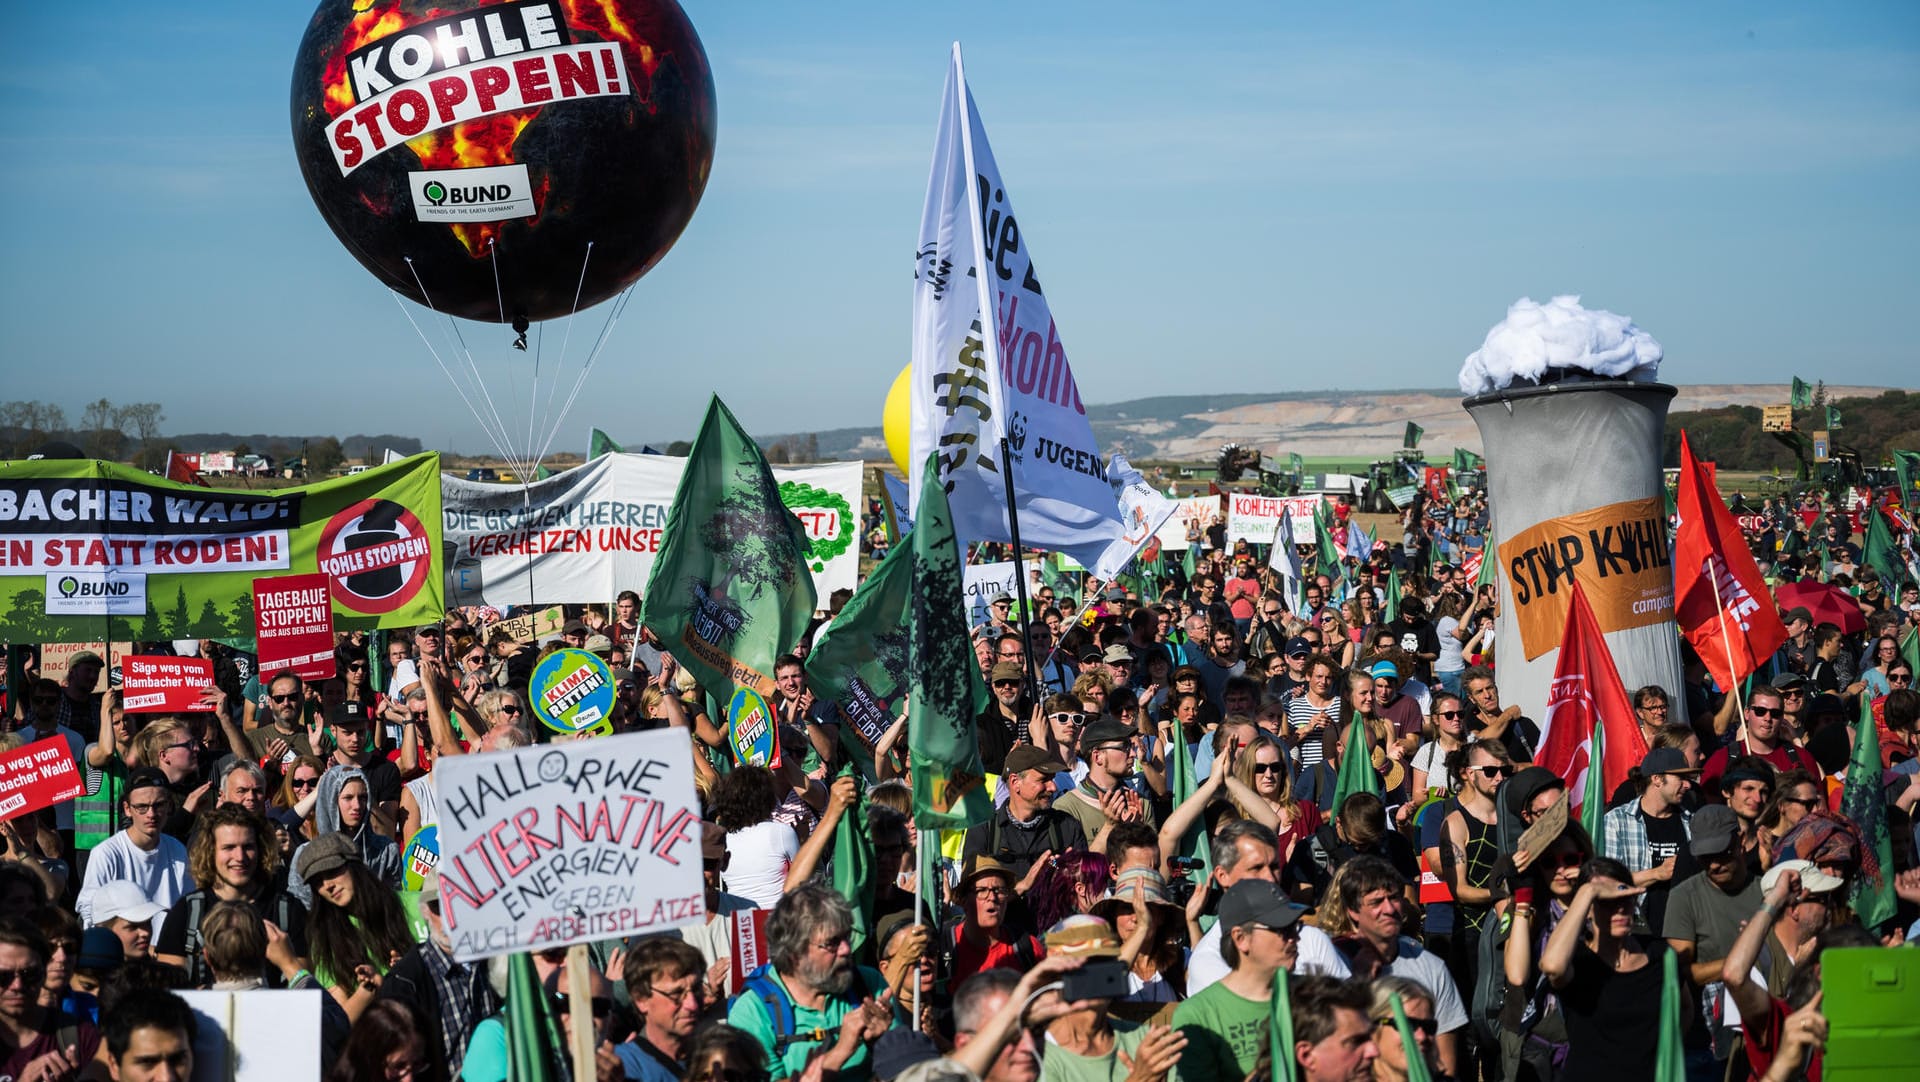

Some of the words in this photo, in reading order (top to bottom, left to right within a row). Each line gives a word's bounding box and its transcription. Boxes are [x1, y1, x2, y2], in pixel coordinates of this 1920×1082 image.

[351, 3, 561, 100] KOHLE
[334, 48, 621, 168] STOPPEN!
[450, 184, 511, 203] BUND
[427, 207, 448, 215] FRIENDS
[487, 205, 514, 213] GERMANY
[444, 508, 480, 531] DIE
[485, 503, 572, 531] GRAUEN
[44, 538, 147, 567] STATT
[155, 535, 278, 565] RODEN!
[469, 528, 591, 556] VERHEIZEN
[320, 552, 365, 577] KOHLE
[365, 537, 429, 568] STOPPEN!
[81, 582, 129, 596] BUND
[257, 588, 328, 610] TAGEBAUE
[261, 606, 326, 628] STOPPEN!
[259, 629, 276, 639] RAUS
[278, 628, 291, 637] AUS
[292, 626, 305, 635] DER
[306, 624, 328, 634] KOHLE!
[132, 661, 157, 675] Säge
[160, 663, 181, 675] weg
[183, 666, 204, 675] vom
[125, 677, 182, 688] Hambacher
[185, 677, 213, 688] Wald!
[546, 668, 591, 703] KLIMA
[548, 673, 604, 719] RETTEN!
[850, 679, 882, 721] HAMBACHER
[737, 710, 761, 738] KLIMA
[738, 718, 768, 754] RETTEN!
[7, 755, 34, 771] weg
[33, 747, 60, 763] vom
[39, 758, 74, 779] Wald!
[572, 758, 670, 796] RWE
[439, 795, 702, 930] ALTERNATIVE
[502, 847, 640, 922] ENERGIEN
[551, 885, 635, 912] GEBEN
[456, 926, 518, 951] AUCH
